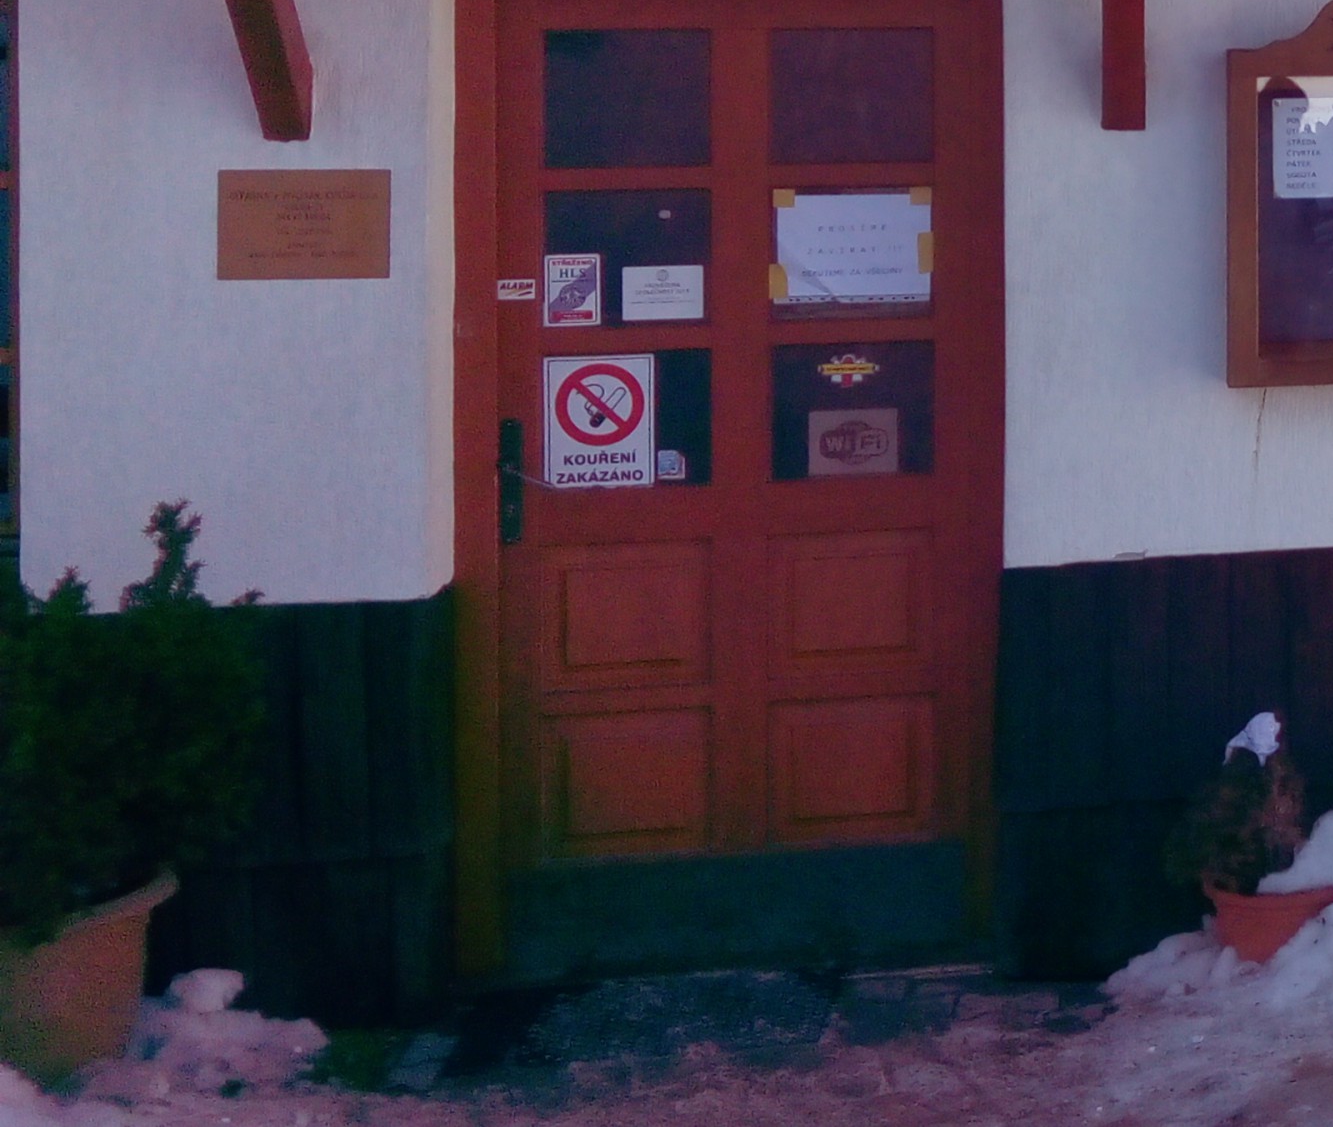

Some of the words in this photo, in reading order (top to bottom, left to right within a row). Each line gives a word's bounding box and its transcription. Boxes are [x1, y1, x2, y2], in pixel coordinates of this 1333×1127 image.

[559, 268, 587, 279] HLS
[563, 449, 636, 466] KOUŘENÍ
[556, 468, 644, 484] ZAKÁZÁNO
